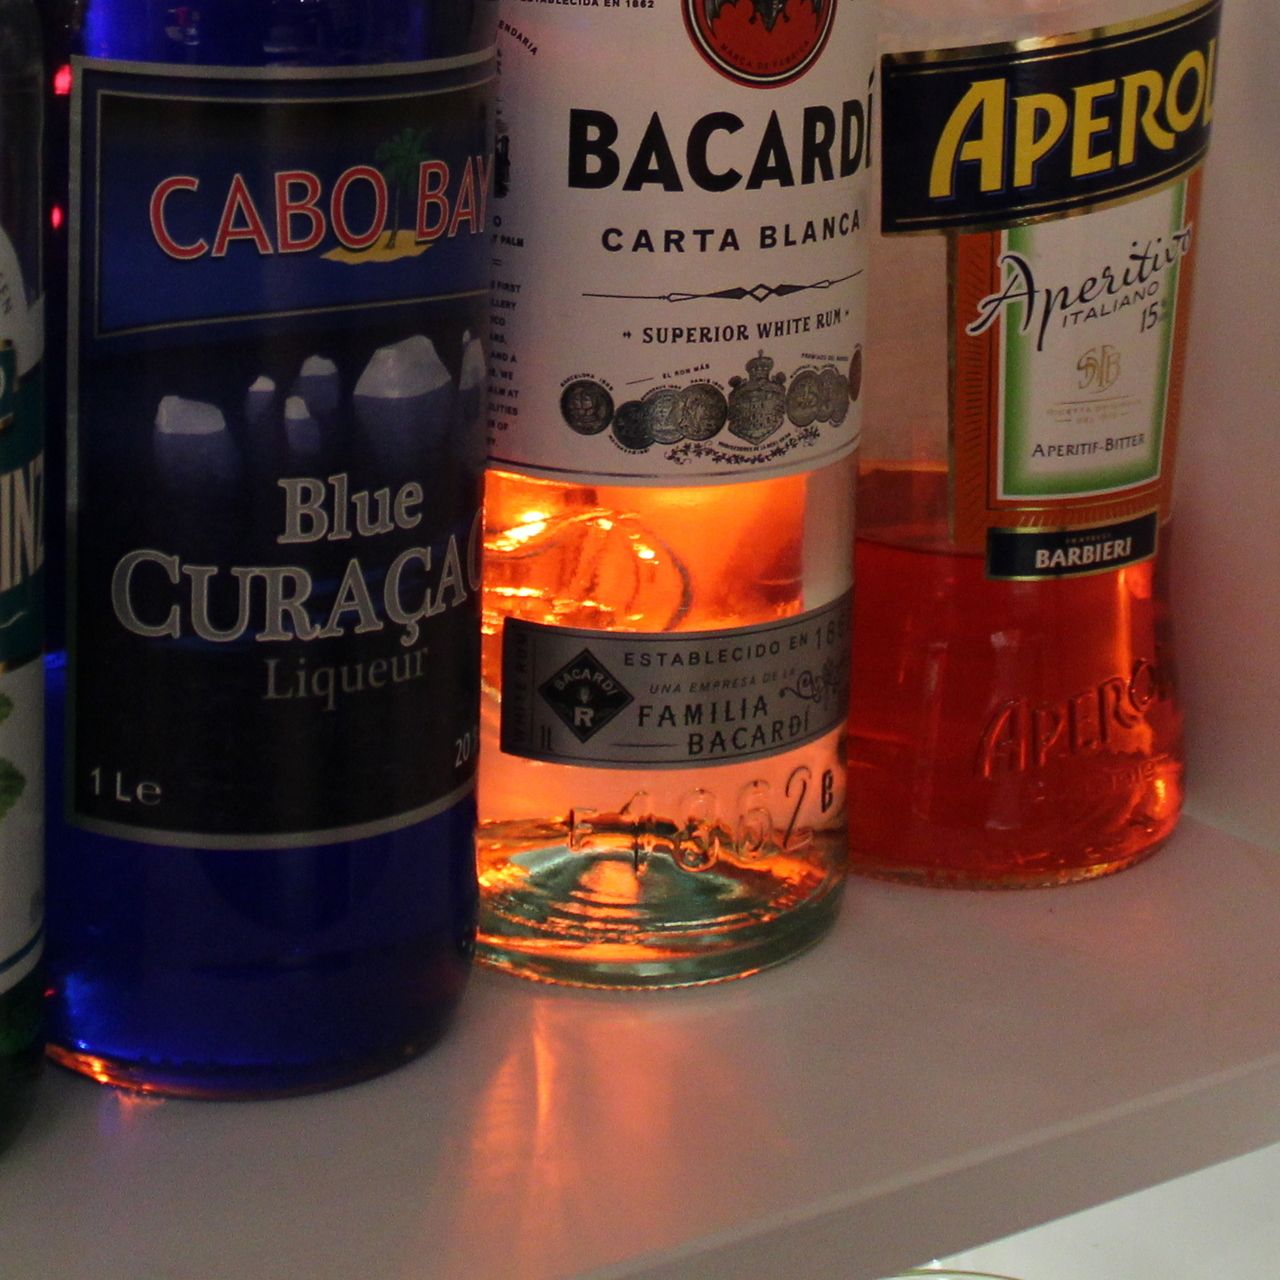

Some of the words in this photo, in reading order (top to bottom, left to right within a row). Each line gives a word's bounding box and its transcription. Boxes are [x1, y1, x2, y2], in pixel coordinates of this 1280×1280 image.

[567, 66, 876, 193] BACARDÍ
[927, 37, 1217, 199] APEROL
[149, 164, 390, 261] CABO
[413, 153, 494, 244] BAY
[601, 227, 741, 253] CARTA
[759, 208, 861, 250] BLANCA
[642, 323, 750, 344] SUPERIOR
[757, 316, 811, 339] WHITE
[815, 307, 843, 329] RUM
[1062, 280, 1160, 329] ITALIANO
[1031, 432, 1146, 458] APERITIF-BITTER
[276, 469, 424, 545] Blue
[1035, 536, 1133, 569] BARBIERI
[623, 639, 781, 667] ESTABLECIDO
[788, 630, 809, 651] EN
[261, 646, 429, 712] Liqueur
[648, 681, 683, 696] UNA
[688, 675, 757, 694] EMPRESA
[762, 671, 778, 685] DE
[637, 695, 769, 729] FAMILIA
